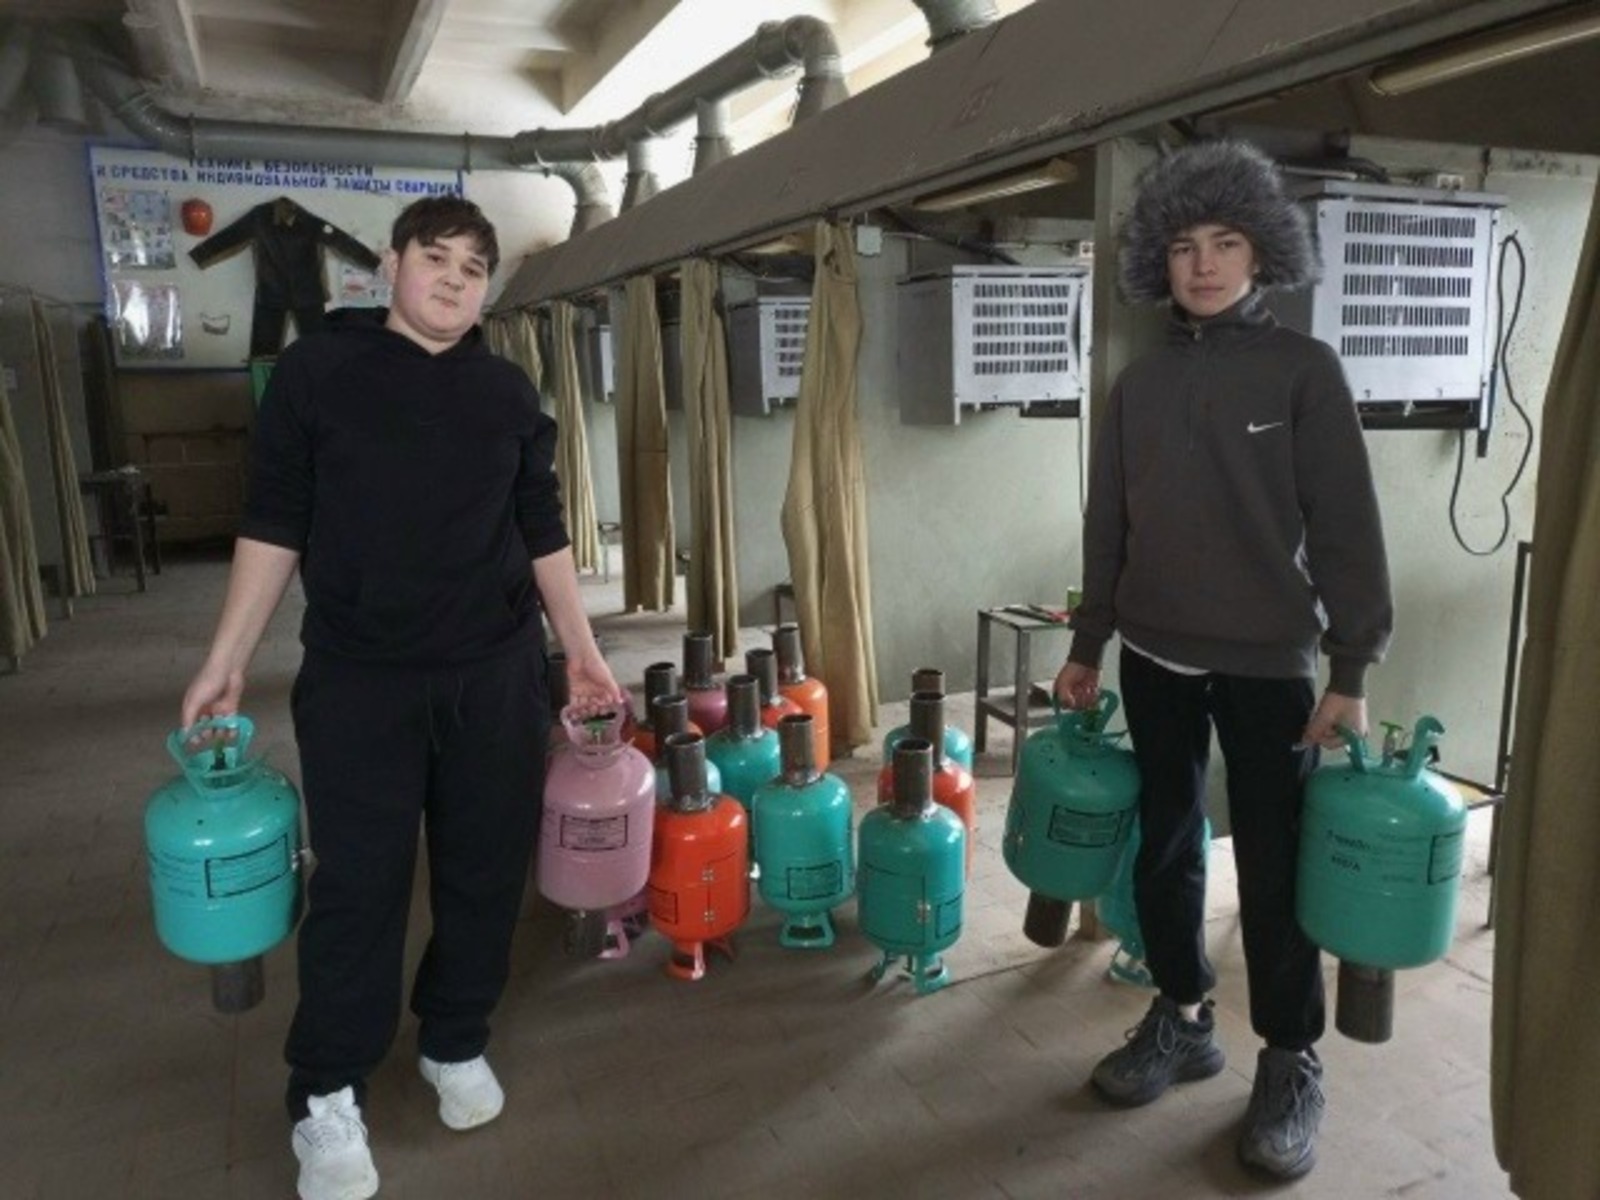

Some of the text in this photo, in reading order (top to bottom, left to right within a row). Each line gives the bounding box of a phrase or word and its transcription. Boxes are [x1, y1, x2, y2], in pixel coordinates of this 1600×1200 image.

[97, 165, 106, 177] И
[112, 165, 188, 181] СРЕДСТВА
[197, 171, 328, 188] ИНДИВИДУАЛЬНОЙ
[335, 178, 391, 191] ЗАЩИТЫ
[264, 160, 373, 176] БЕЗОПАСНОСТИ
